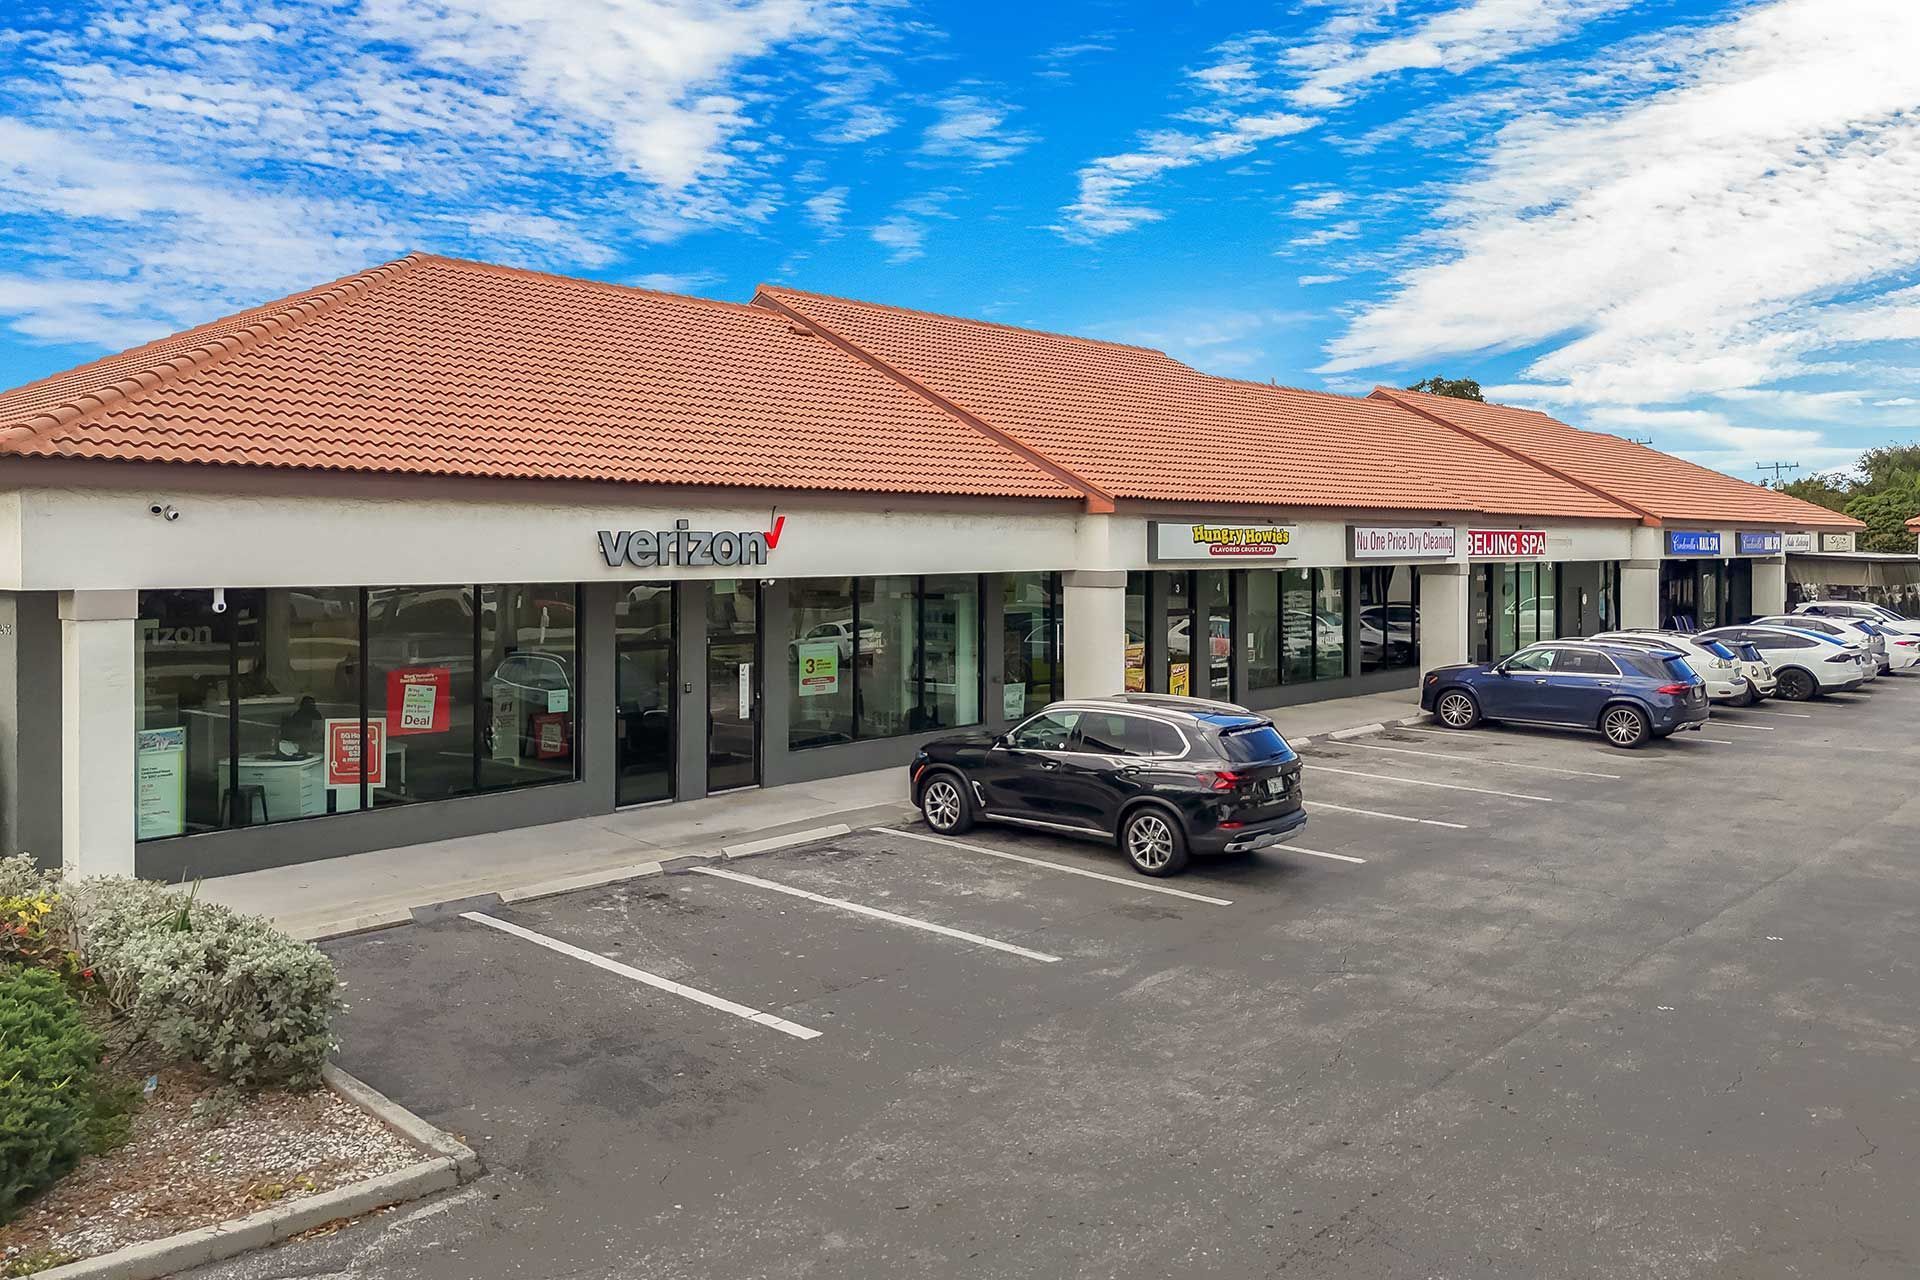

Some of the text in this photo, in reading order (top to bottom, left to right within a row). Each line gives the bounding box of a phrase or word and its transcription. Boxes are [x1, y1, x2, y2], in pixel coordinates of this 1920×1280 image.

[598, 519, 768, 567] verizon
[1193, 525, 1290, 544] Hungry Howie's
[1357, 531, 1453, 554] Nu One Price Dry Cleaning
[1468, 533, 1545, 555] BEIJING SPA
[1709, 536, 1719, 551] SPA
[1175, 583, 1181, 593] 3
[805, 658, 815, 674] 3
[404, 714, 430, 725] Deal
